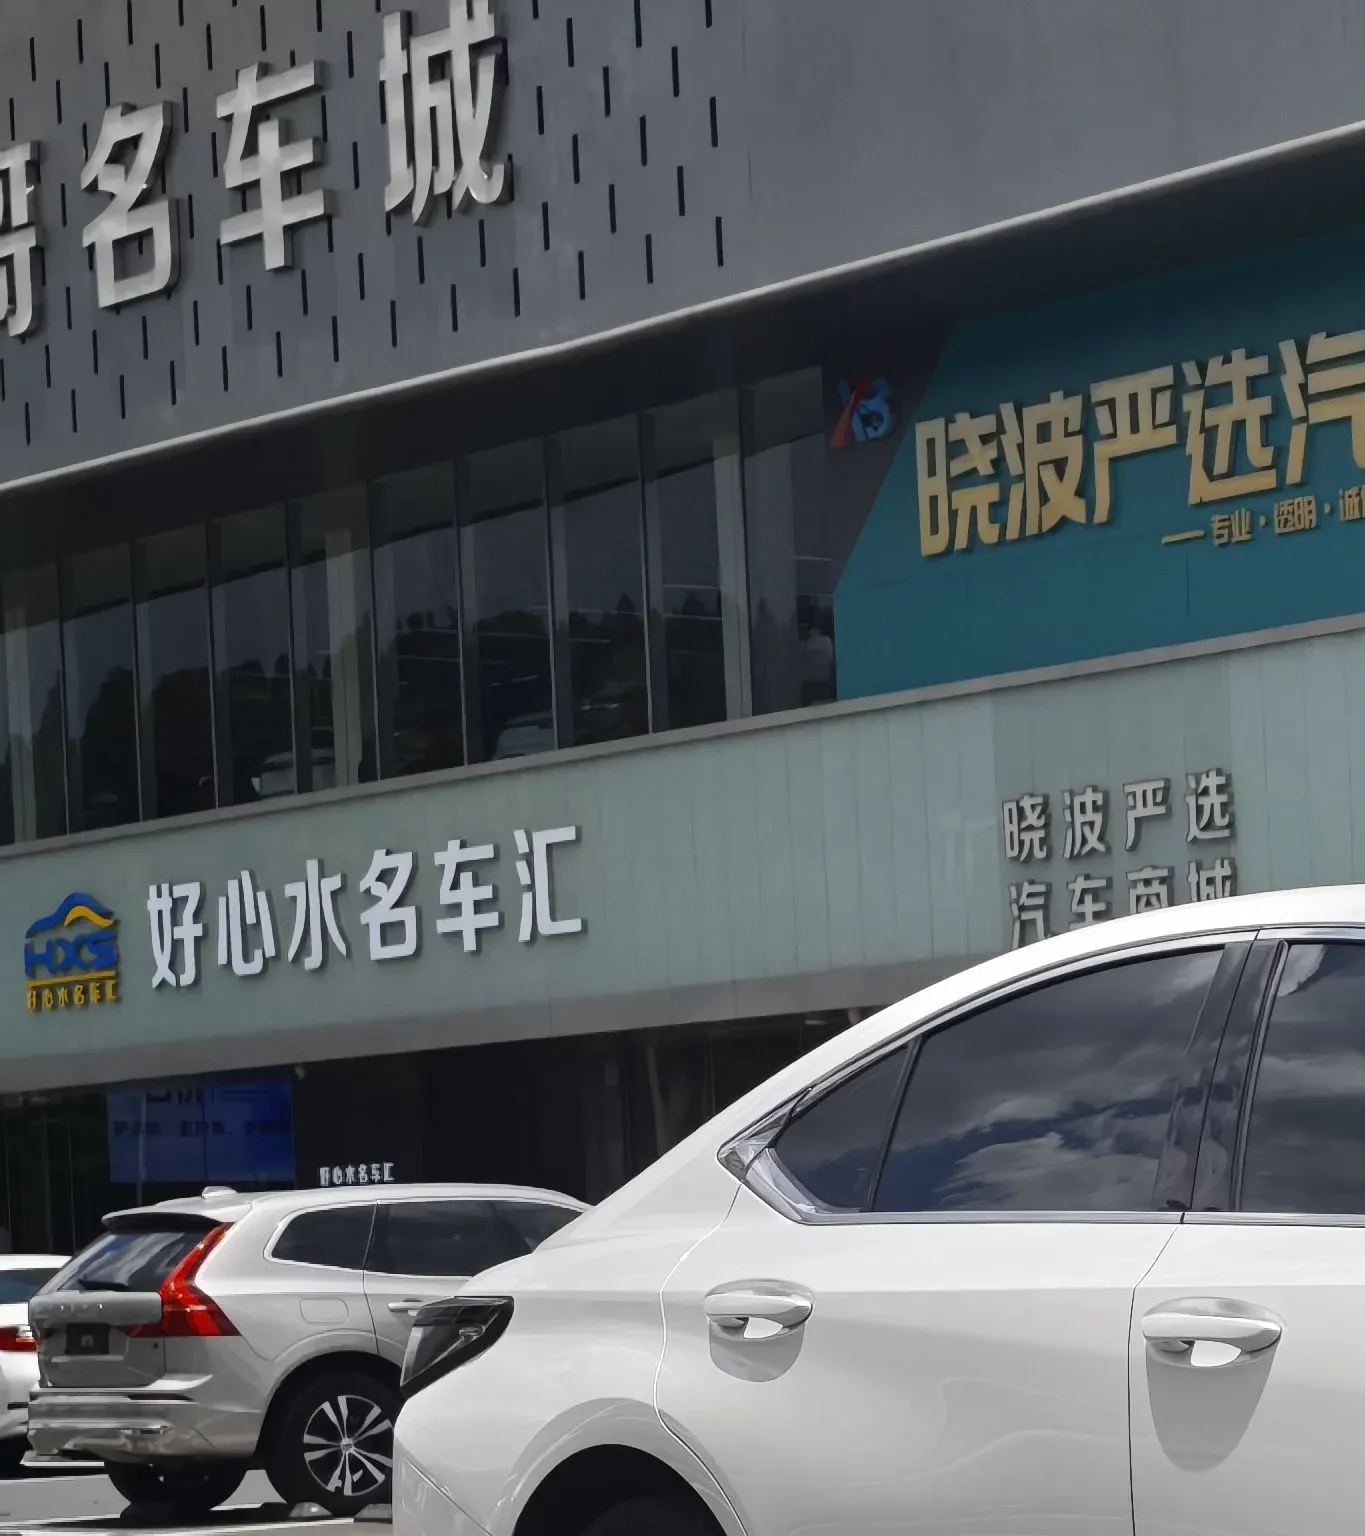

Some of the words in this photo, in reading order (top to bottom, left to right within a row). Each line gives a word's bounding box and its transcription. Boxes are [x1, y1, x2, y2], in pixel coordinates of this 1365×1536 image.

[1002, 768, 1233, 862] 晓波严选
[24, 930, 118, 978] HXS
[147, 825, 585, 989] 好心水名车汇
